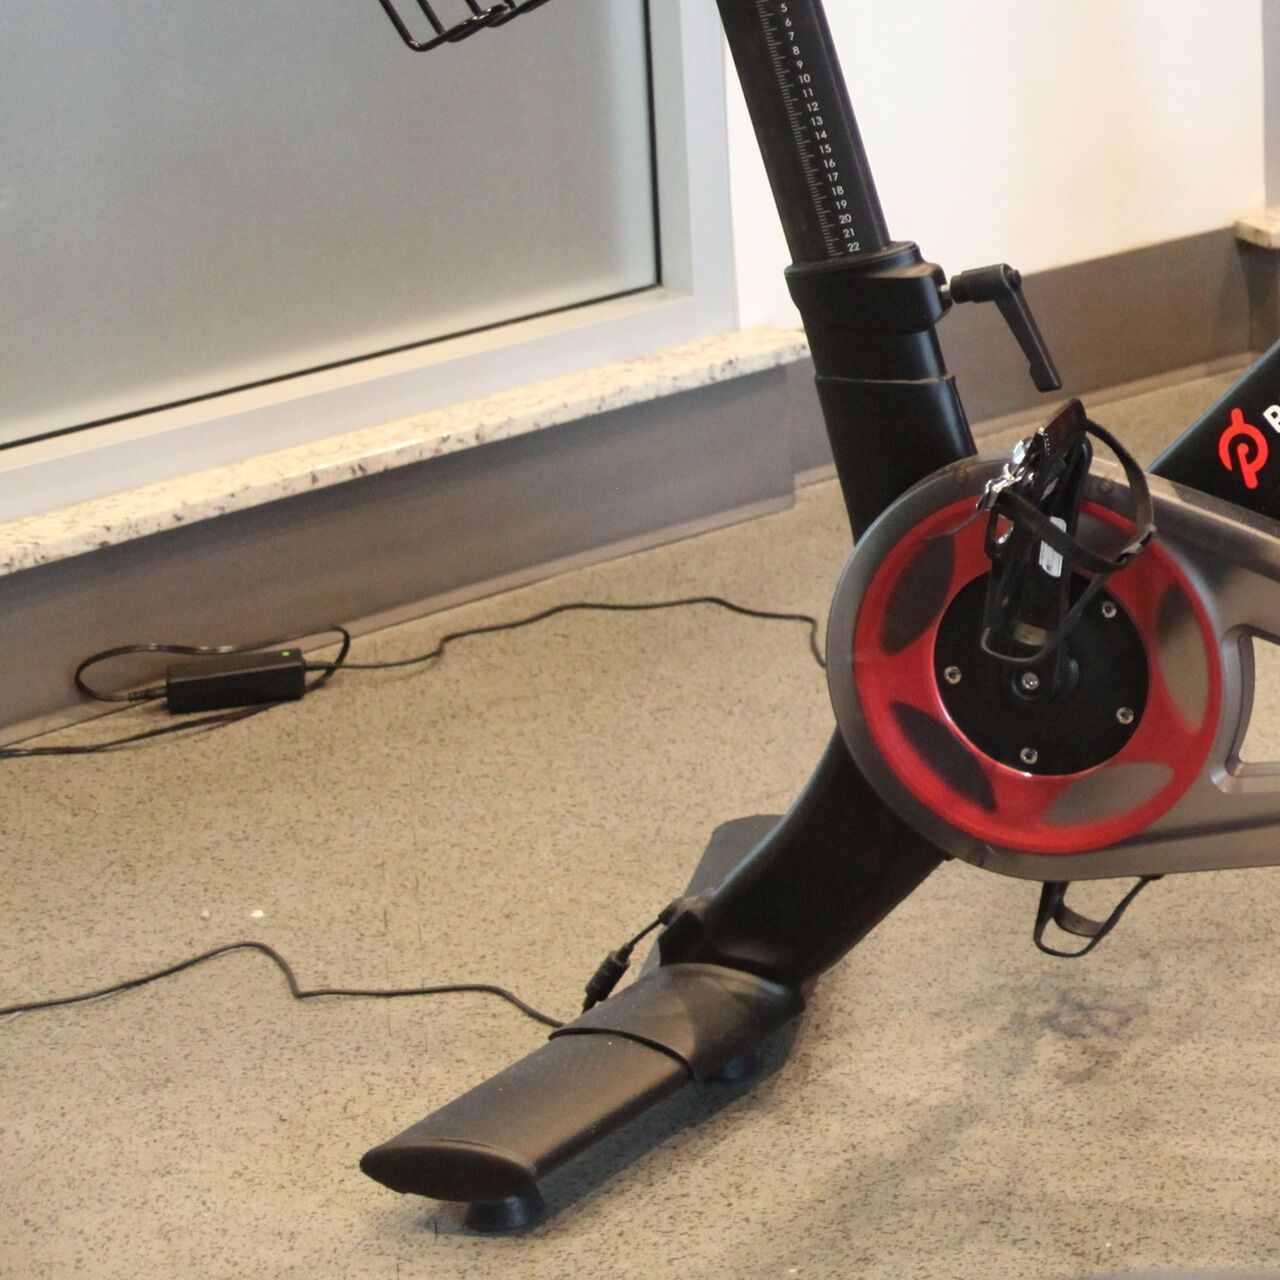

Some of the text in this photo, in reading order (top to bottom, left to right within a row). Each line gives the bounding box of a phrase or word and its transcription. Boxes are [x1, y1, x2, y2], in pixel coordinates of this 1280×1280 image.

[798, 74, 810, 83] 10
[802, 88, 814, 98] 11
[806, 102, 819, 112] 12
[810, 116, 824, 126] 13
[814, 130, 827, 140] 14
[819, 144, 832, 154] 15
[823, 159, 836, 168] 16
[828, 173, 839, 182] 17
[831, 186, 844, 196] 18
[836, 200, 847, 210] 19
[839, 214, 852, 224] 20
[843, 228, 855, 237] 21
[848, 242, 860, 252] 22
